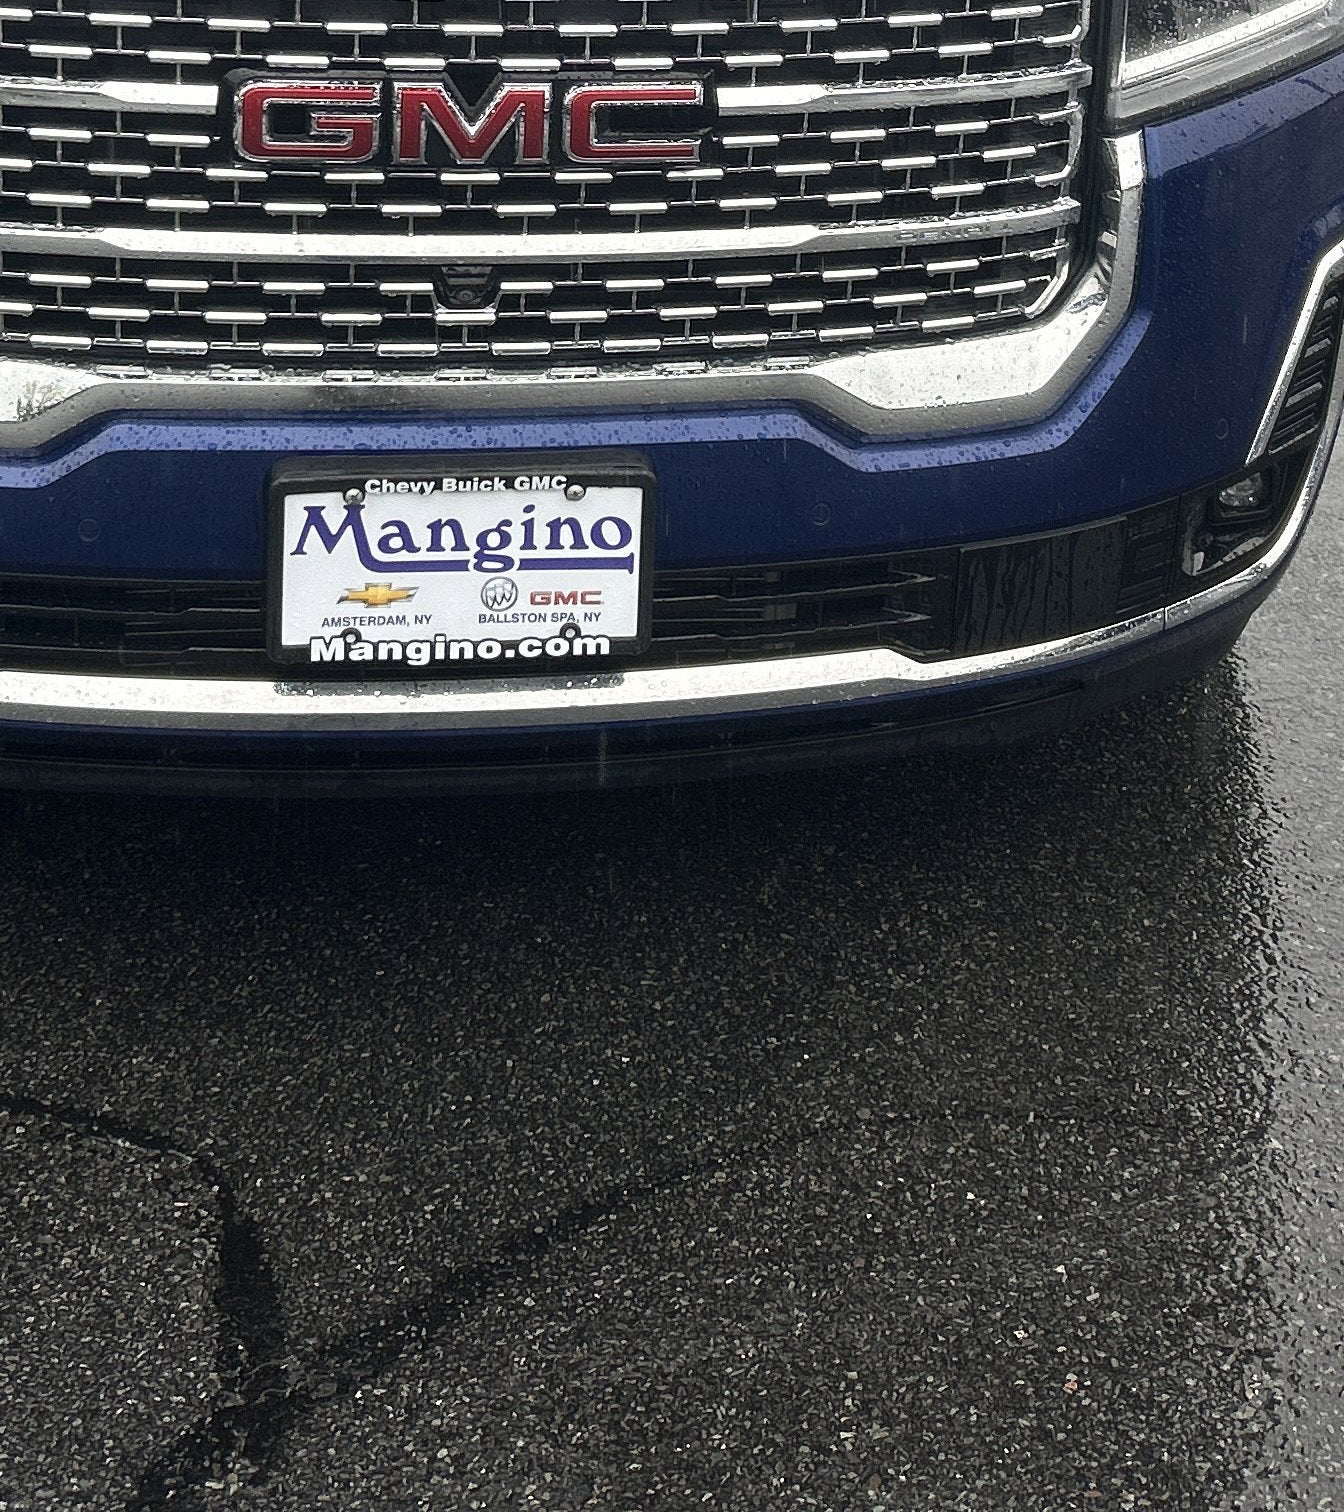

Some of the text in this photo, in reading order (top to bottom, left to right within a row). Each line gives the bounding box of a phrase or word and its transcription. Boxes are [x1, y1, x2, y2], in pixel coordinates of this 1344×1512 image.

[233, 78, 705, 165] GMC
[364, 475, 568, 496] Chevy Buick GMC
[289, 504, 635, 574] Mangino
[529, 590, 603, 606] GMC
[321, 614, 433, 629] AMSTERDAM, NY
[478, 611, 602, 625] BALLSTON SPA, NY
[309, 634, 610, 666] Mangino.com
